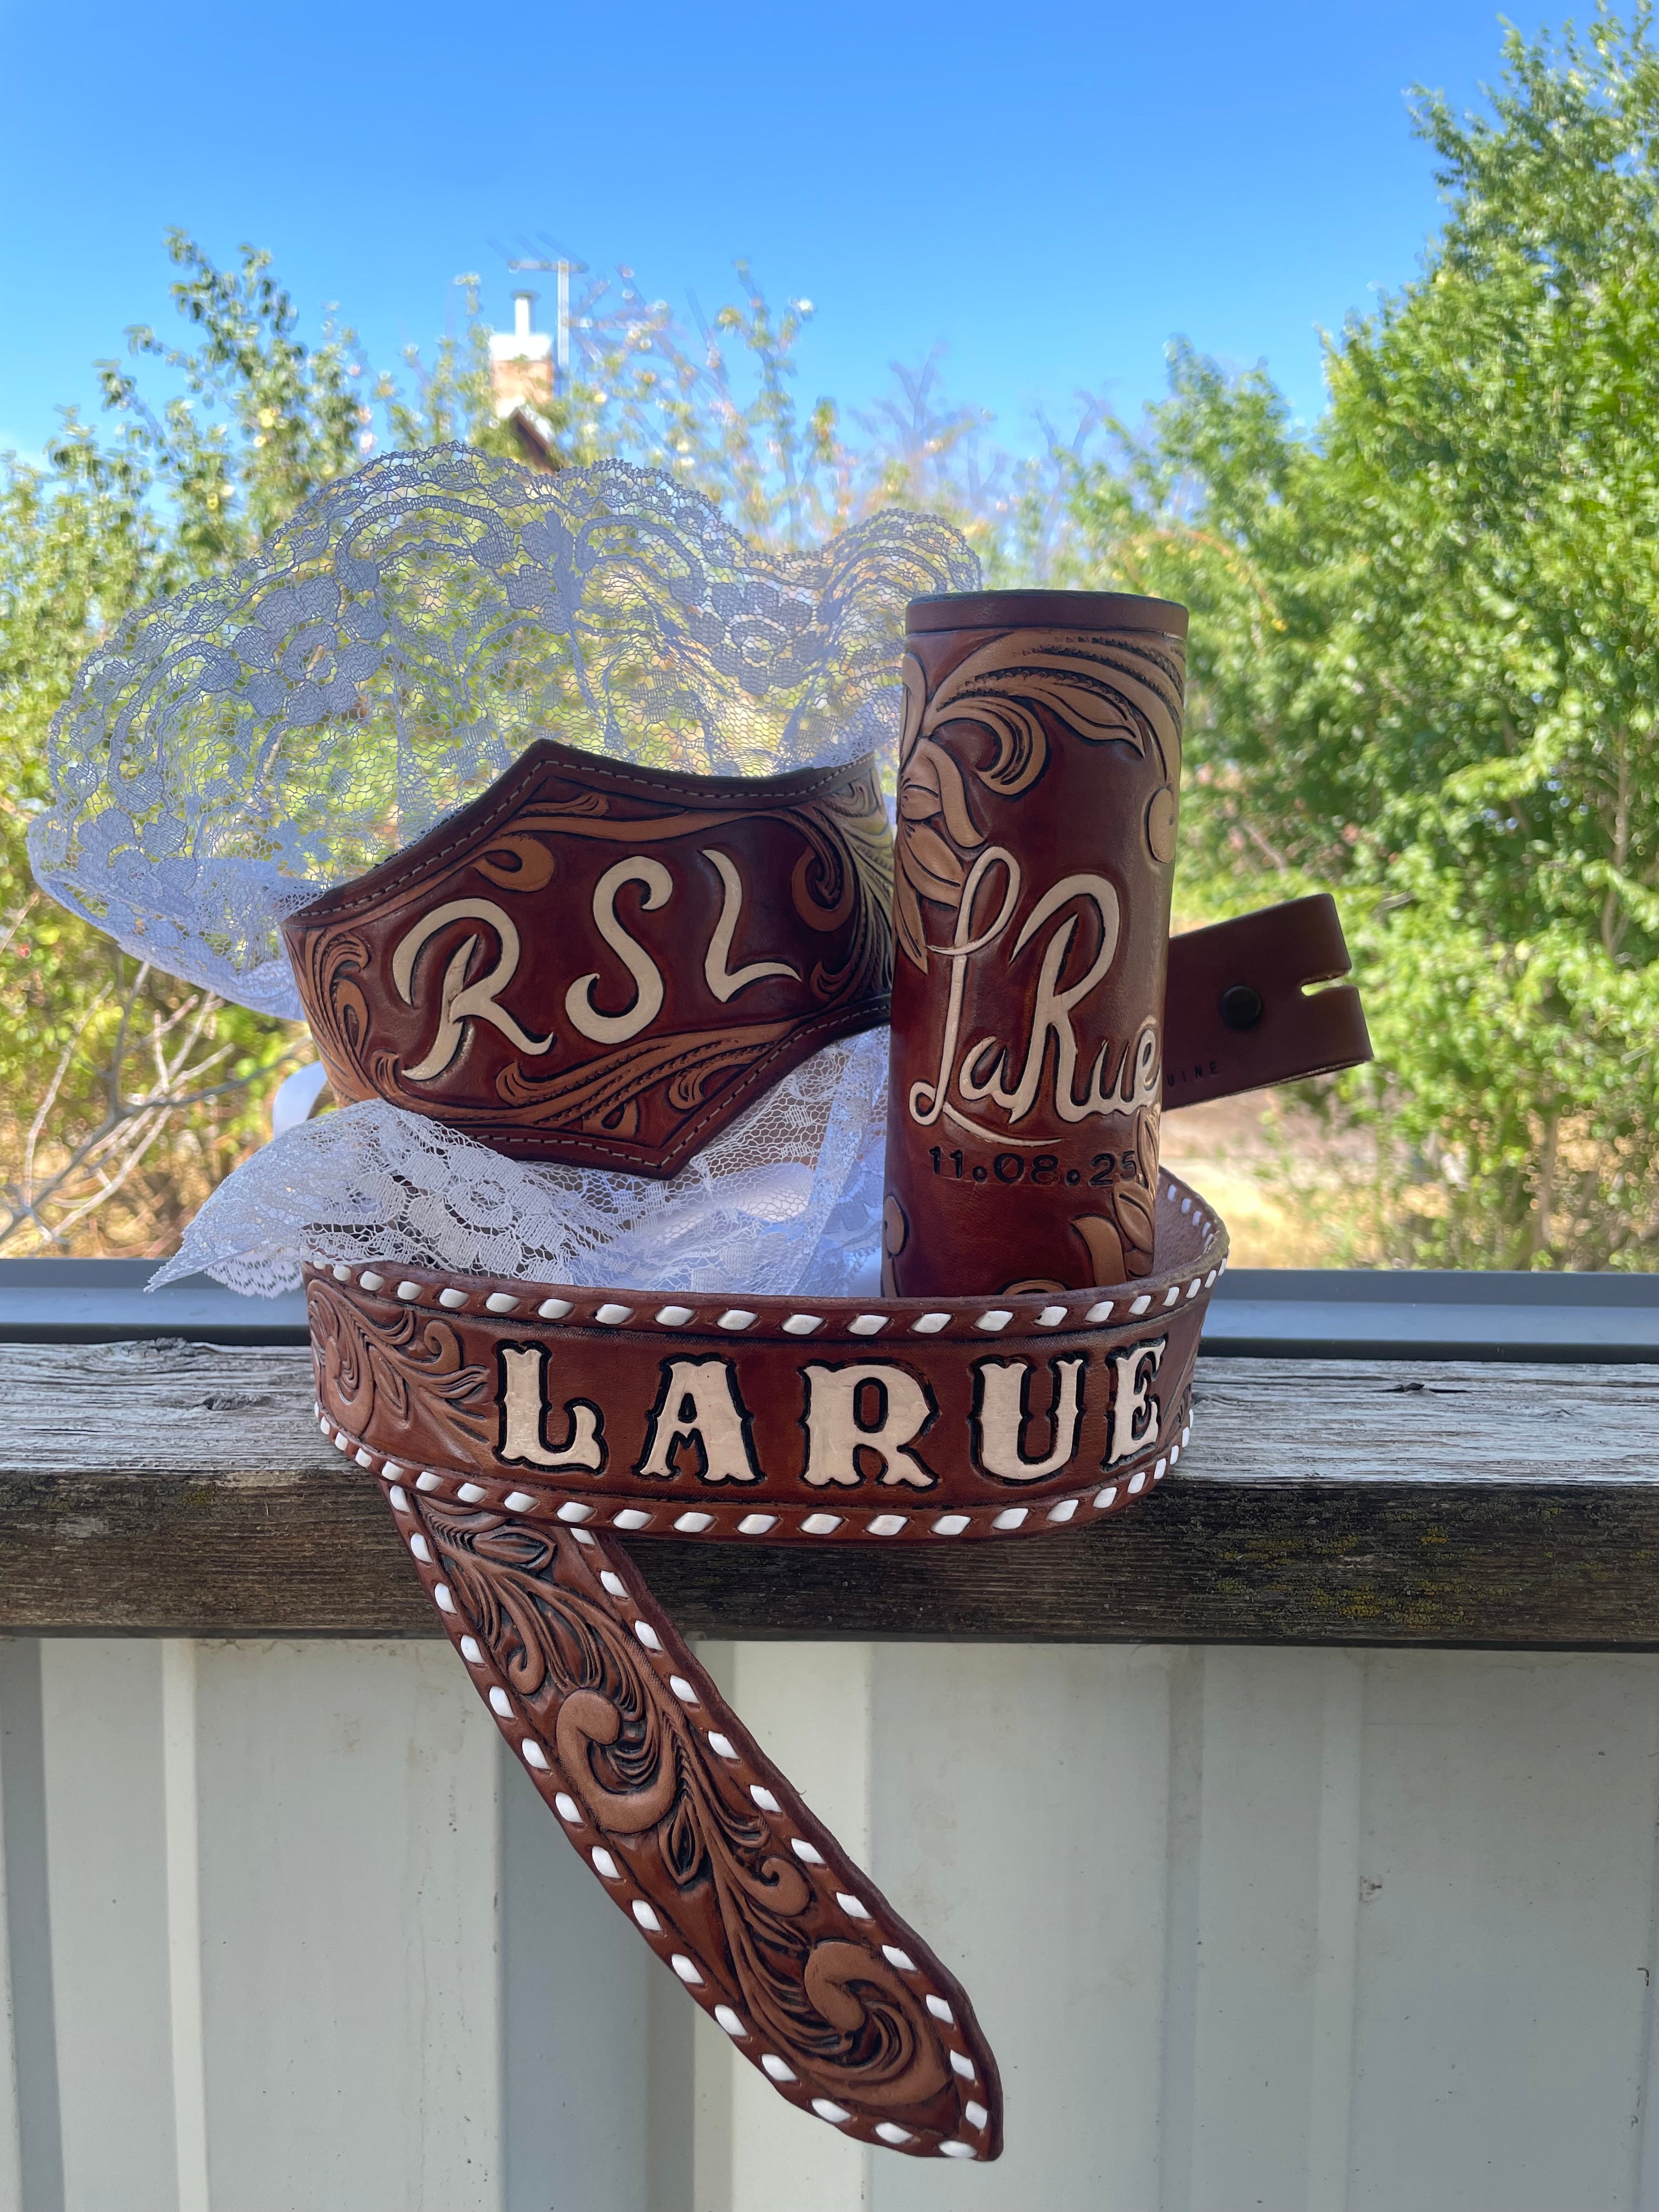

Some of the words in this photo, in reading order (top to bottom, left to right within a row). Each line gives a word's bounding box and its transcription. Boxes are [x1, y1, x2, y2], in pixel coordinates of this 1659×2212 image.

[392, 849, 802, 1081] RSL
[909, 846, 1162, 1147] LaRue
[929, 1146, 1137, 1187] 11.08.25
[495, 1339, 1170, 1491] LARUE
